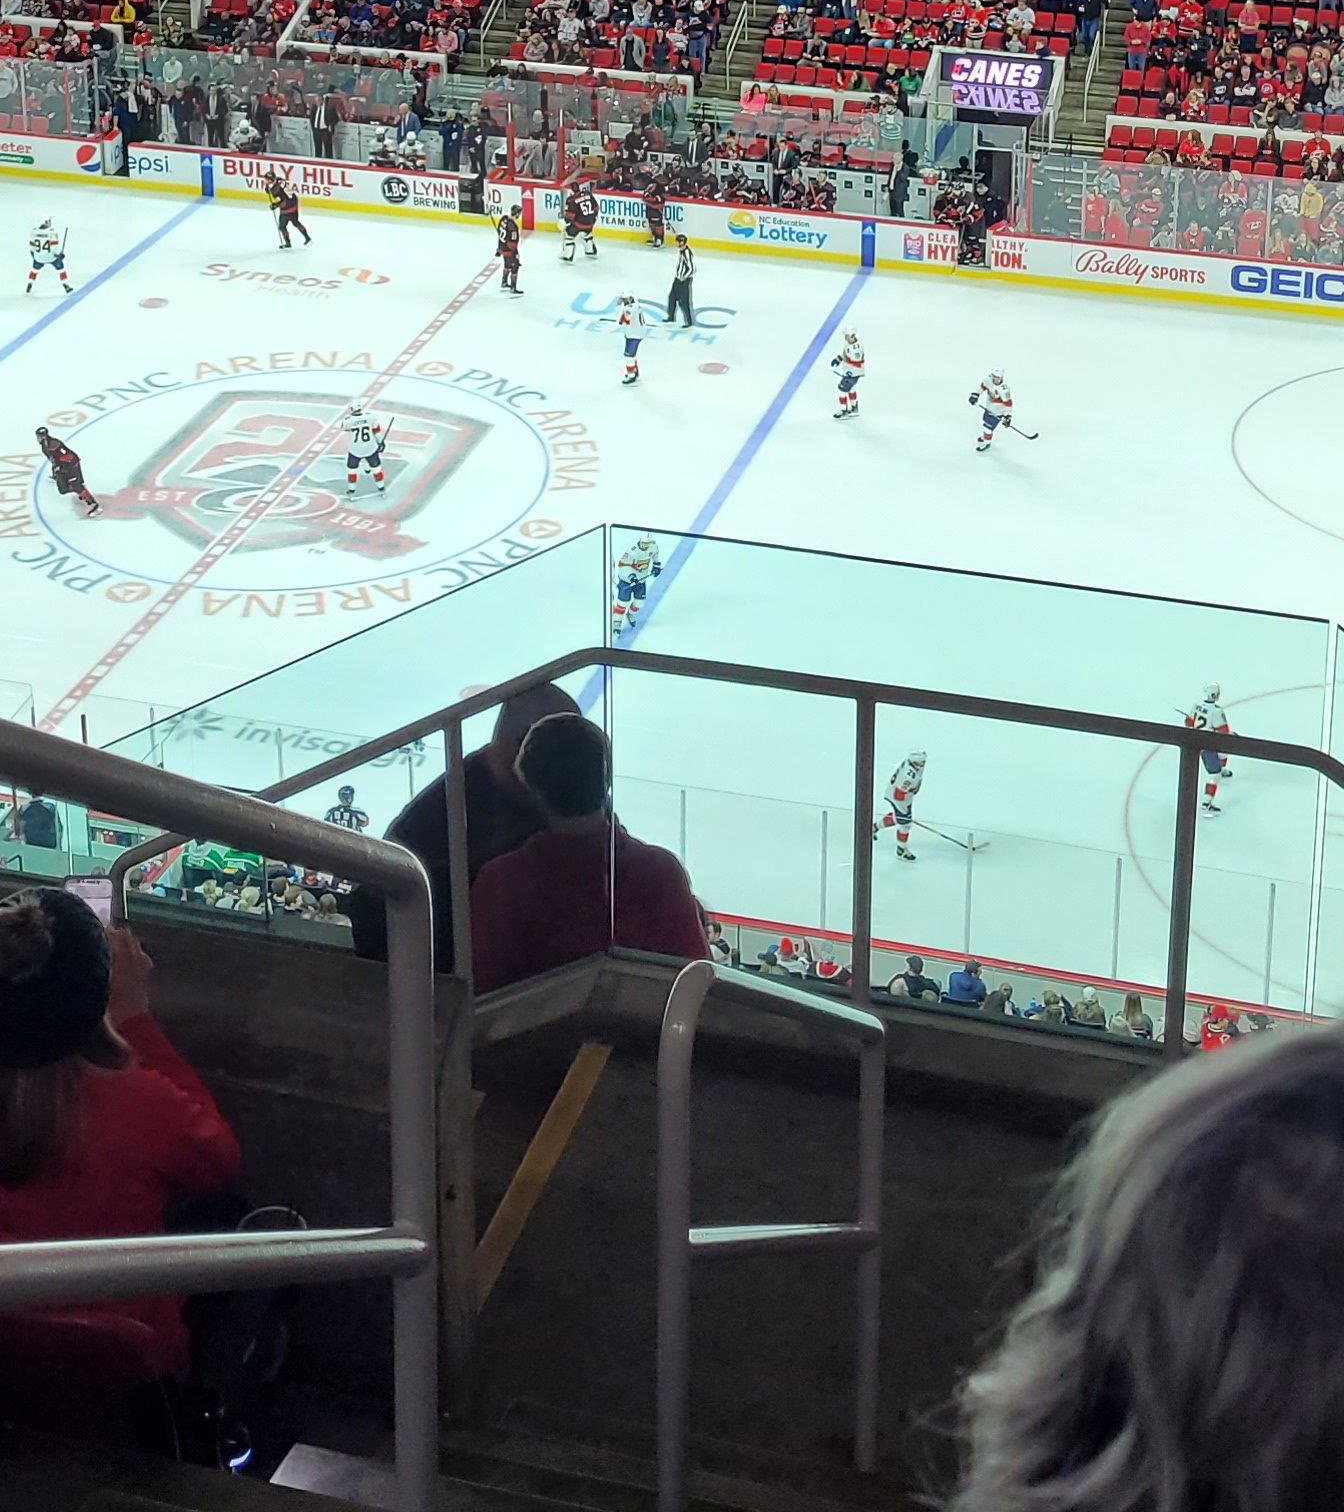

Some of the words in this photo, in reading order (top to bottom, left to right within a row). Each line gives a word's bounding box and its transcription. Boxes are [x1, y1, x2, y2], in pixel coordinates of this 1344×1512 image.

[951, 57, 1042, 88] CANES
[222, 158, 294, 181] BULLY
[303, 166, 354, 188] HILL
[383, 182, 408, 198] LBC
[413, 196, 456, 210] BREWING
[579, 200, 594, 216] 52
[600, 216, 626, 226] TEAM
[758, 215, 771, 225] NC
[772, 216, 810, 228] Education
[758, 223, 828, 249] Lottery
[199, 263, 343, 289] Syneos
[1075, 248, 1150, 284] Bally
[1150, 265, 1206, 285] SPORTS
[72, 371, 182, 412] PNC
[195, 349, 374, 381] ARENA
[352, 426, 371, 444] 76
[452, 367, 547, 410] PNC
[524, 406, 599, 492] ARENA
[137, 490, 188, 502] EST
[330, 512, 387, 533] 1997
